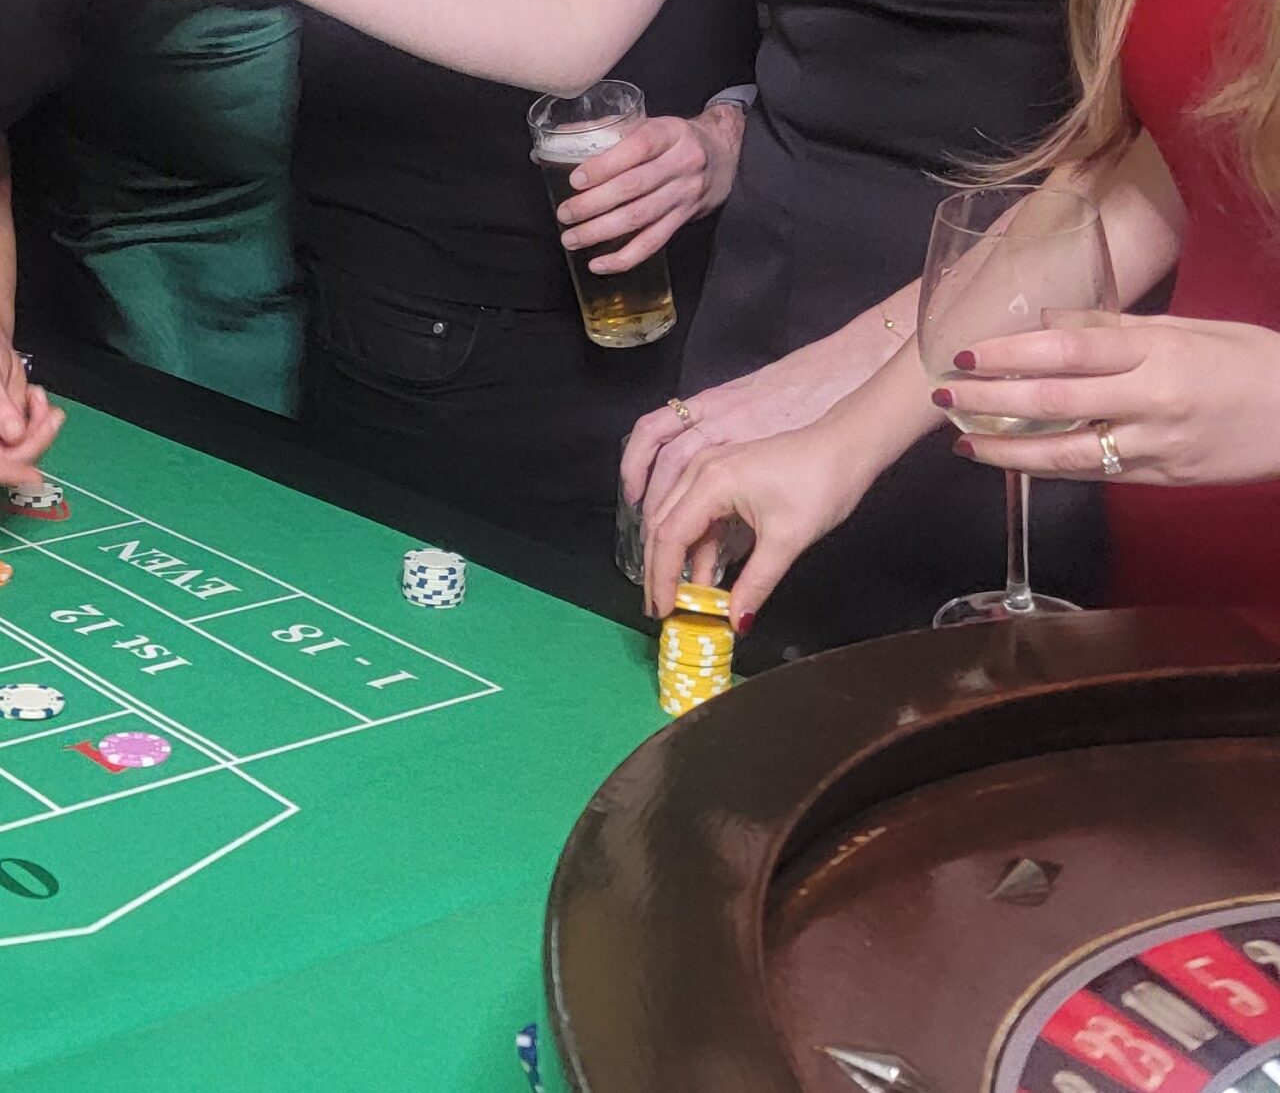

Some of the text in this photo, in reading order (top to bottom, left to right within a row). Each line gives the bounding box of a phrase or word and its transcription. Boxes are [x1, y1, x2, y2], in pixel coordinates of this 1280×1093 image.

[97, 540, 242, 600] EVEN
[50, 603, 193, 675] 1st 12
[271, 624, 351, 656] 18
[365, 670, 419, 689] 1
